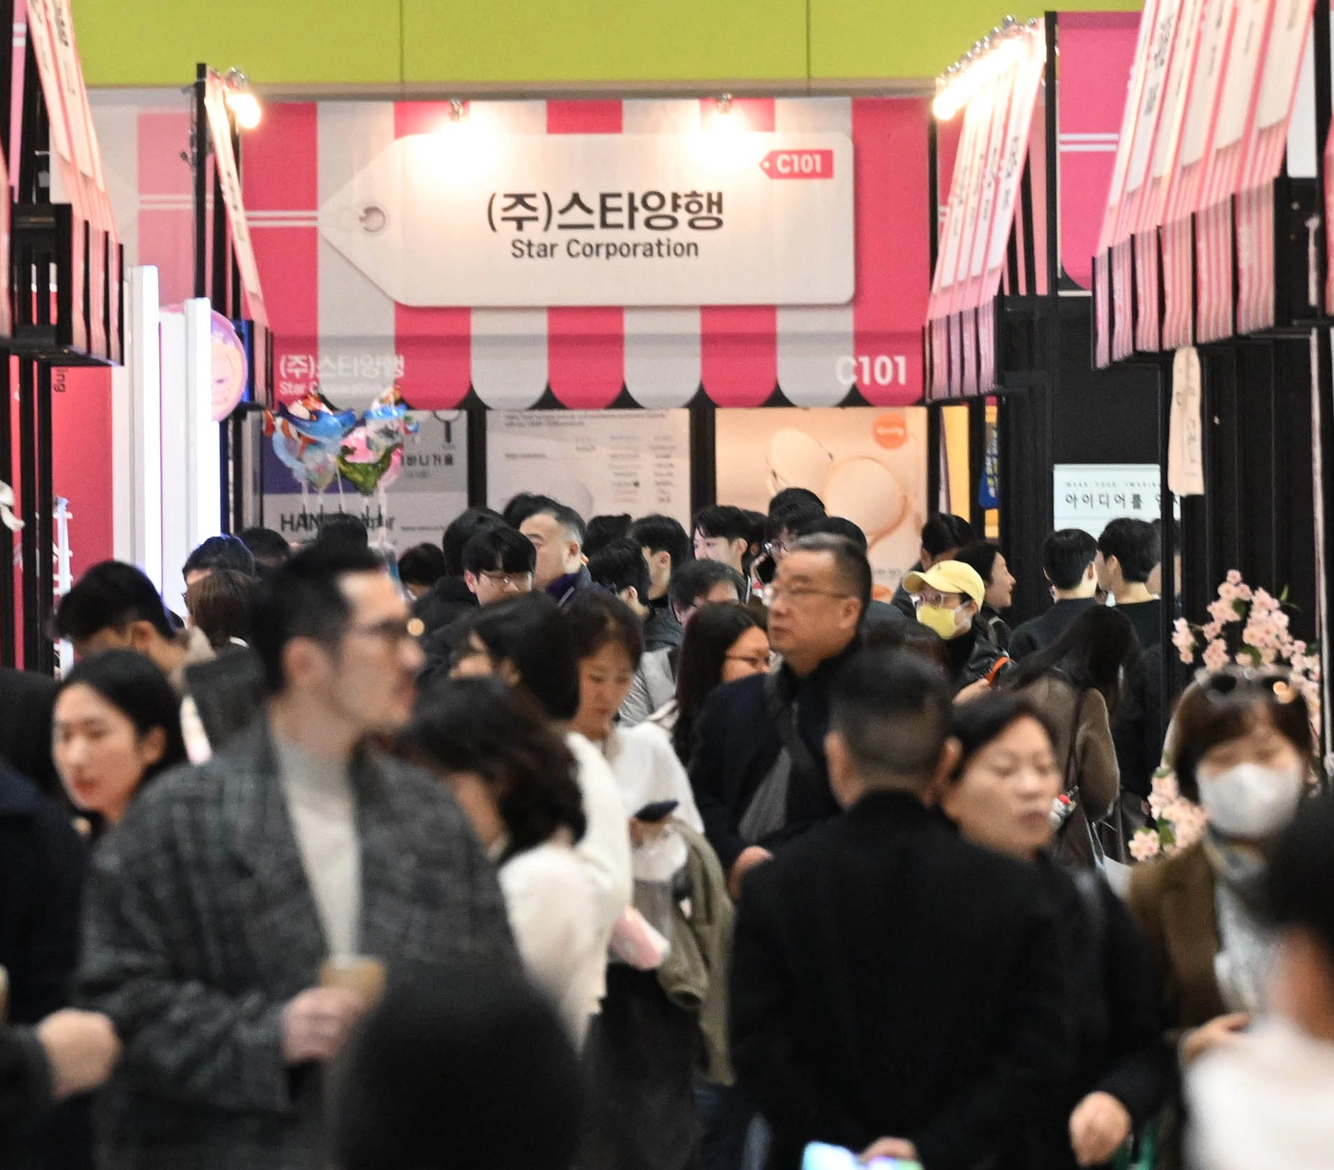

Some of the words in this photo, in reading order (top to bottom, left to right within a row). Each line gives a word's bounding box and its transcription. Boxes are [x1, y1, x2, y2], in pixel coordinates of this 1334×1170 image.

[776, 154, 822, 173] C101
[487, 191, 724, 232] (주)스타양행
[511, 238, 558, 258] Star
[566, 238, 699, 260] Corporation
[836, 355, 906, 386] C101
[1065, 493, 1142, 510] 아이디어를
